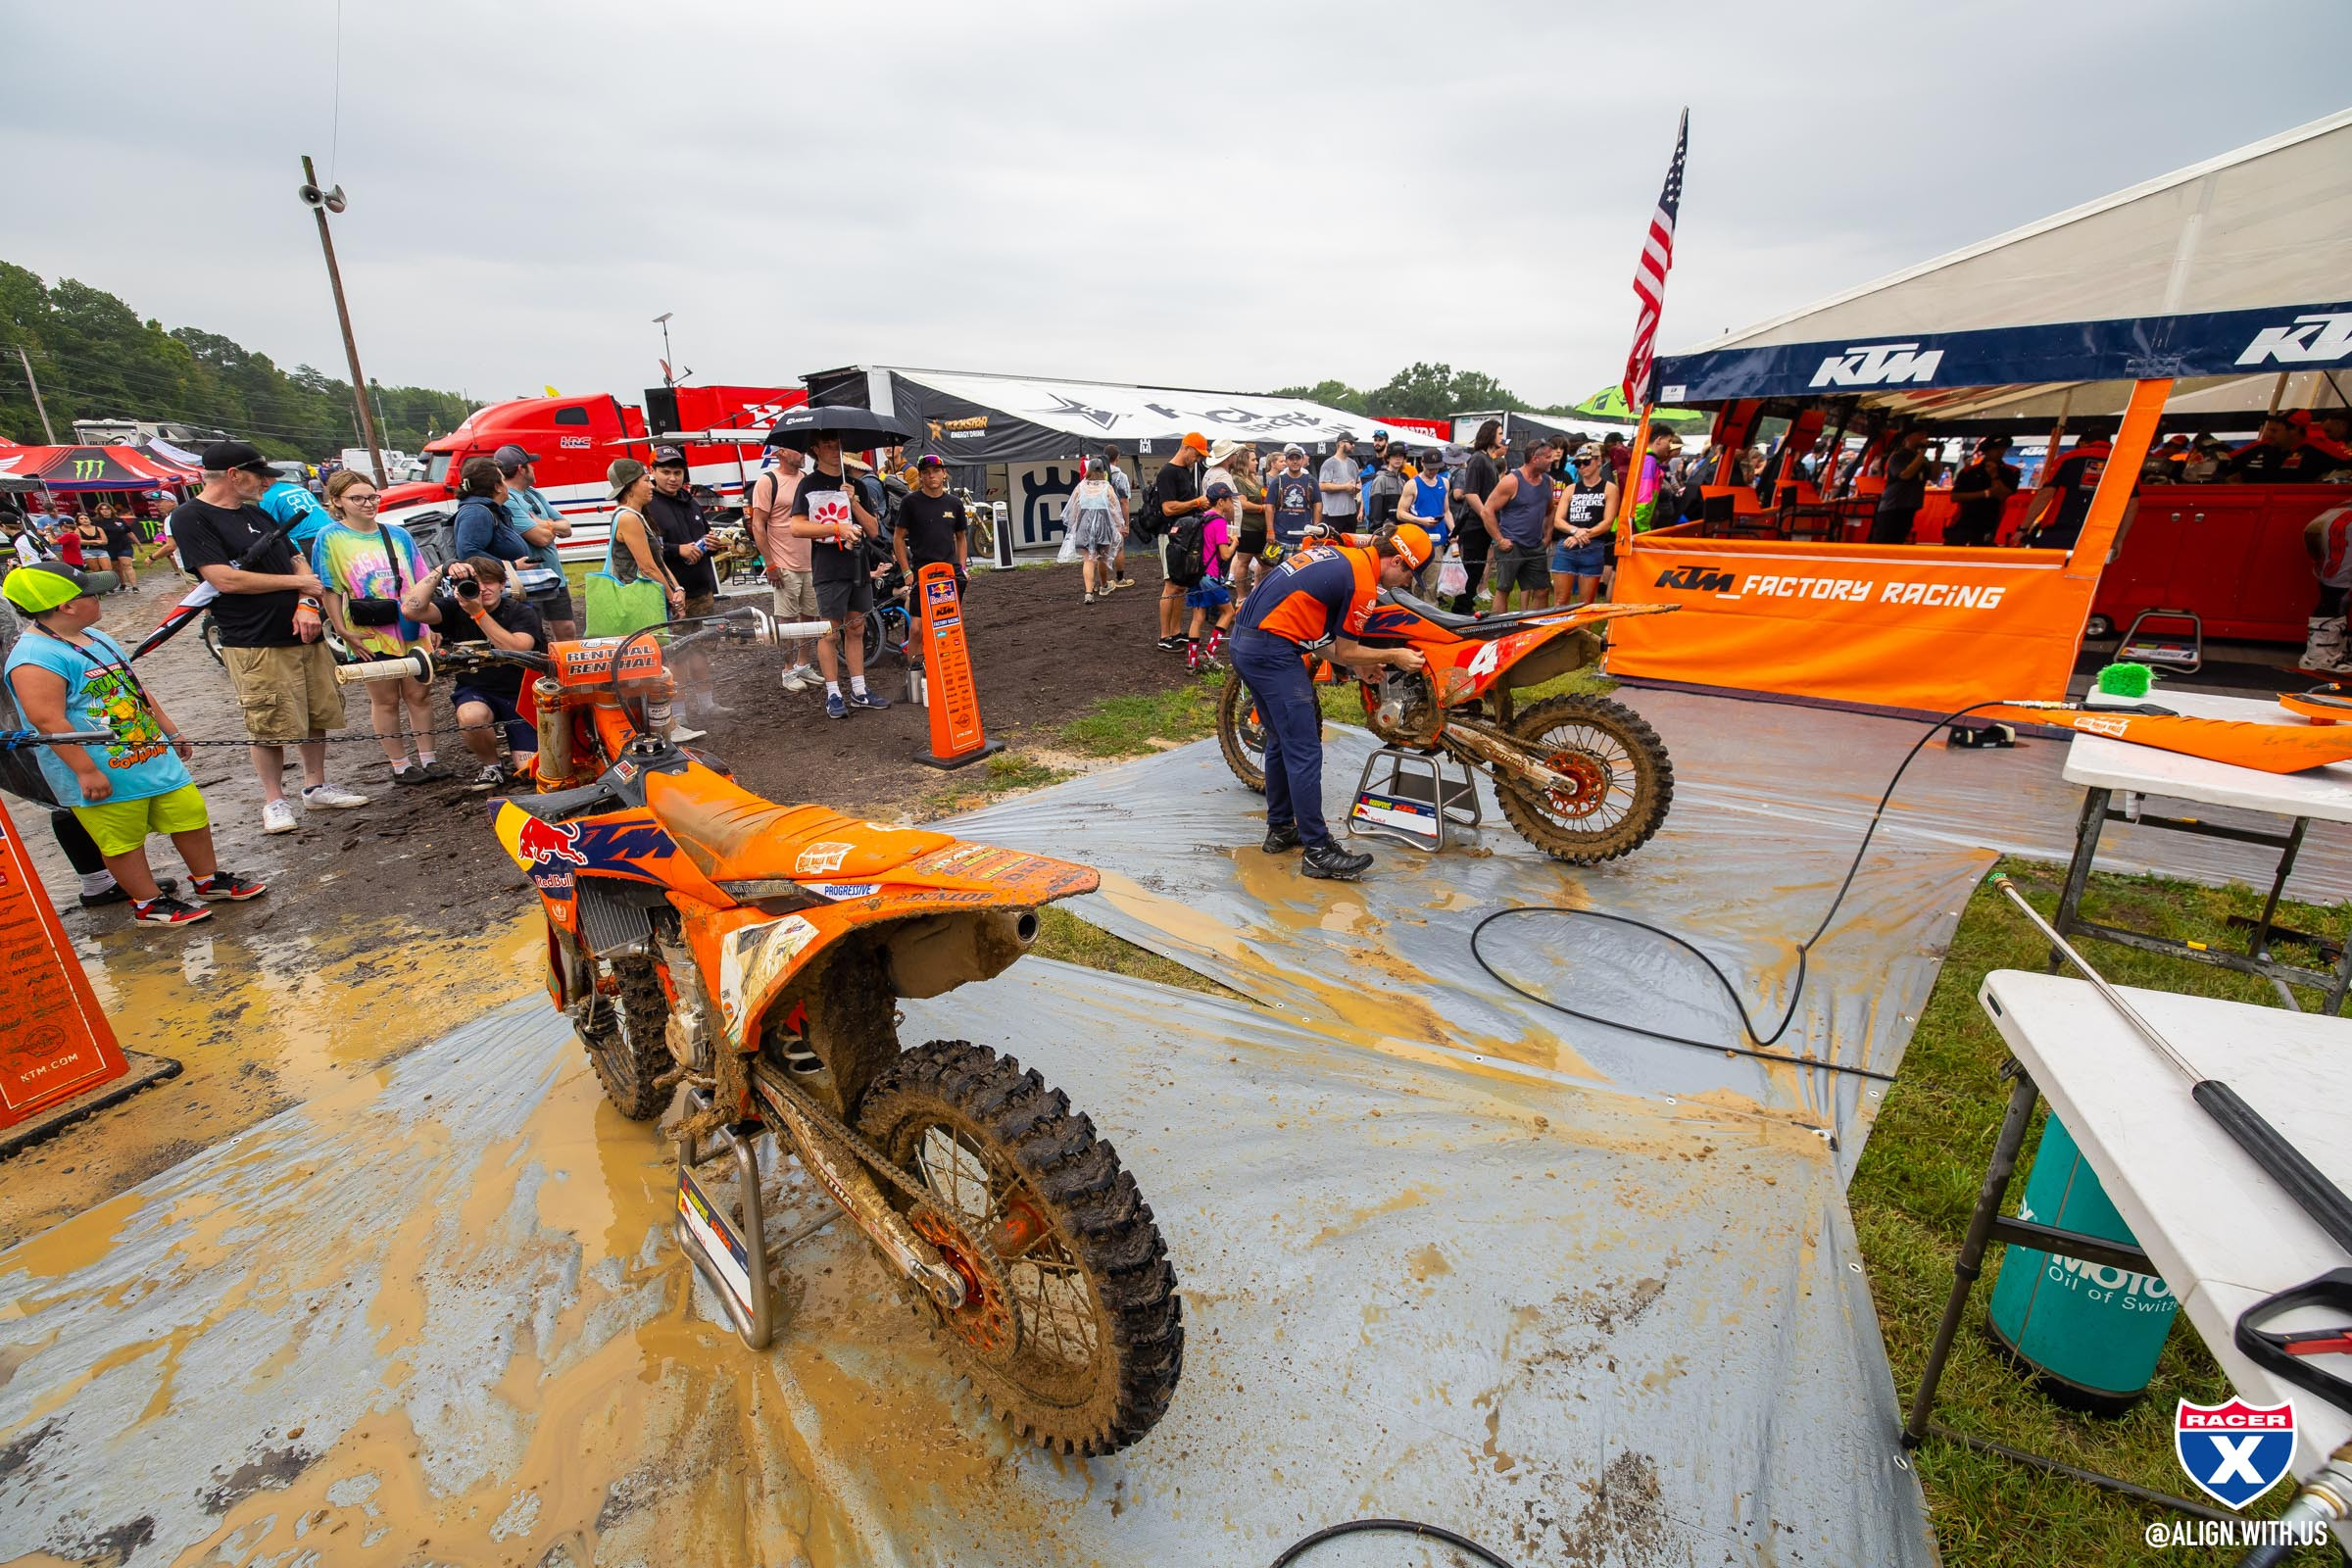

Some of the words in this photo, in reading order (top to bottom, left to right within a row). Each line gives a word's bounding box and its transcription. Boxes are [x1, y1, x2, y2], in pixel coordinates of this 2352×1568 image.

[1808, 343, 1944, 388] KTM
[945, 416, 989, 430] ROCKSTAR
[561, 437, 591, 448] HRC
[1654, 565, 1736, 592] KTM
[936, 606, 954, 615] KTM
[1468, 640, 1498, 676] 4
[824, 885, 871, 896] PROGRESSIVE
[906, 893, 995, 902] DUNLOP
[21, 1054, 78, 1082] KTM.COM
[2049, 1265, 2078, 1291] Oil
[2088, 1289, 2114, 1303] of
[2052, 1253, 2176, 1298] MOTO
